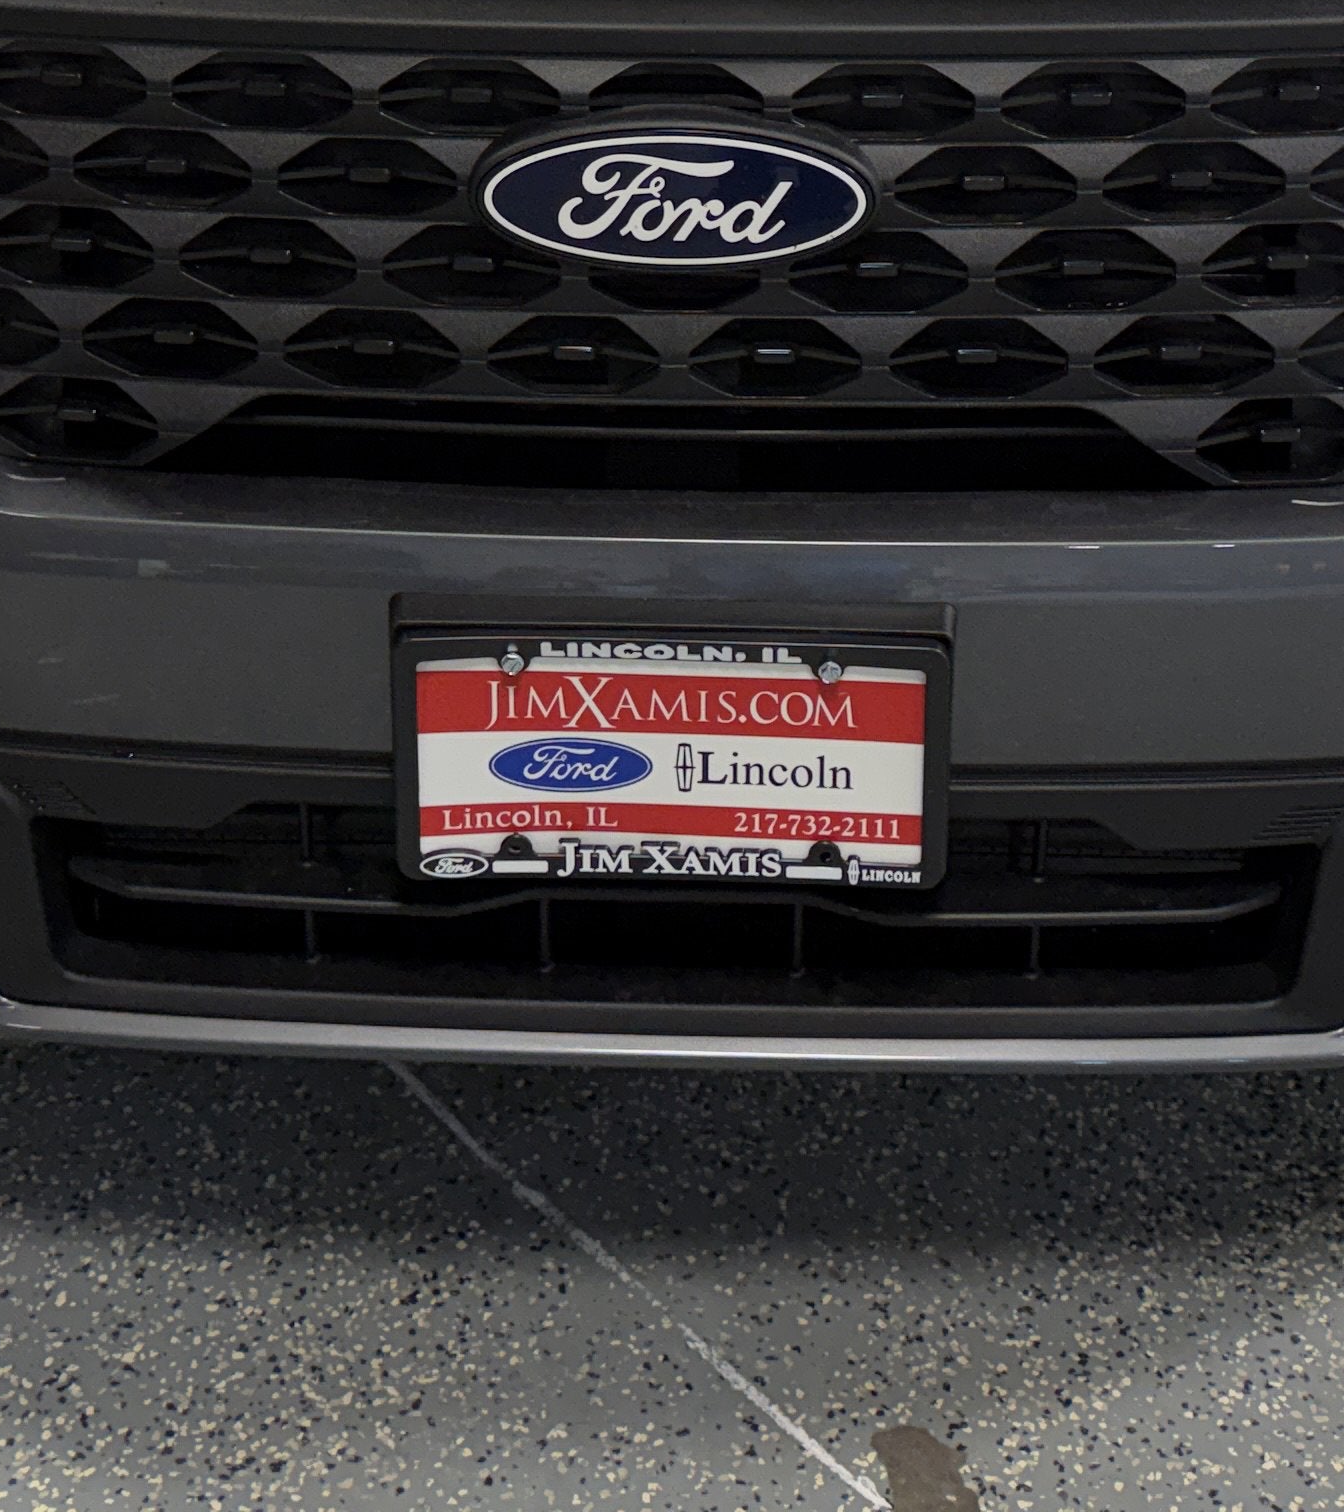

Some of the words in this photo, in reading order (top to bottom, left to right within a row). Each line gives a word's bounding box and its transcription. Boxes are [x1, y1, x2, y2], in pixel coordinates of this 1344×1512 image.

[557, 153, 793, 244] Ford
[761, 646, 802, 664] IL
[522, 744, 619, 783] Ford
[696, 750, 854, 791] Lincoln
[442, 804, 572, 831] Lincoln,
[586, 806, 619, 828] IL
[733, 811, 900, 840] 217-732-2111
[557, 841, 633, 878] JIM
[642, 845, 782, 878] XAMIS
[861, 868, 922, 884] LINCOLN
